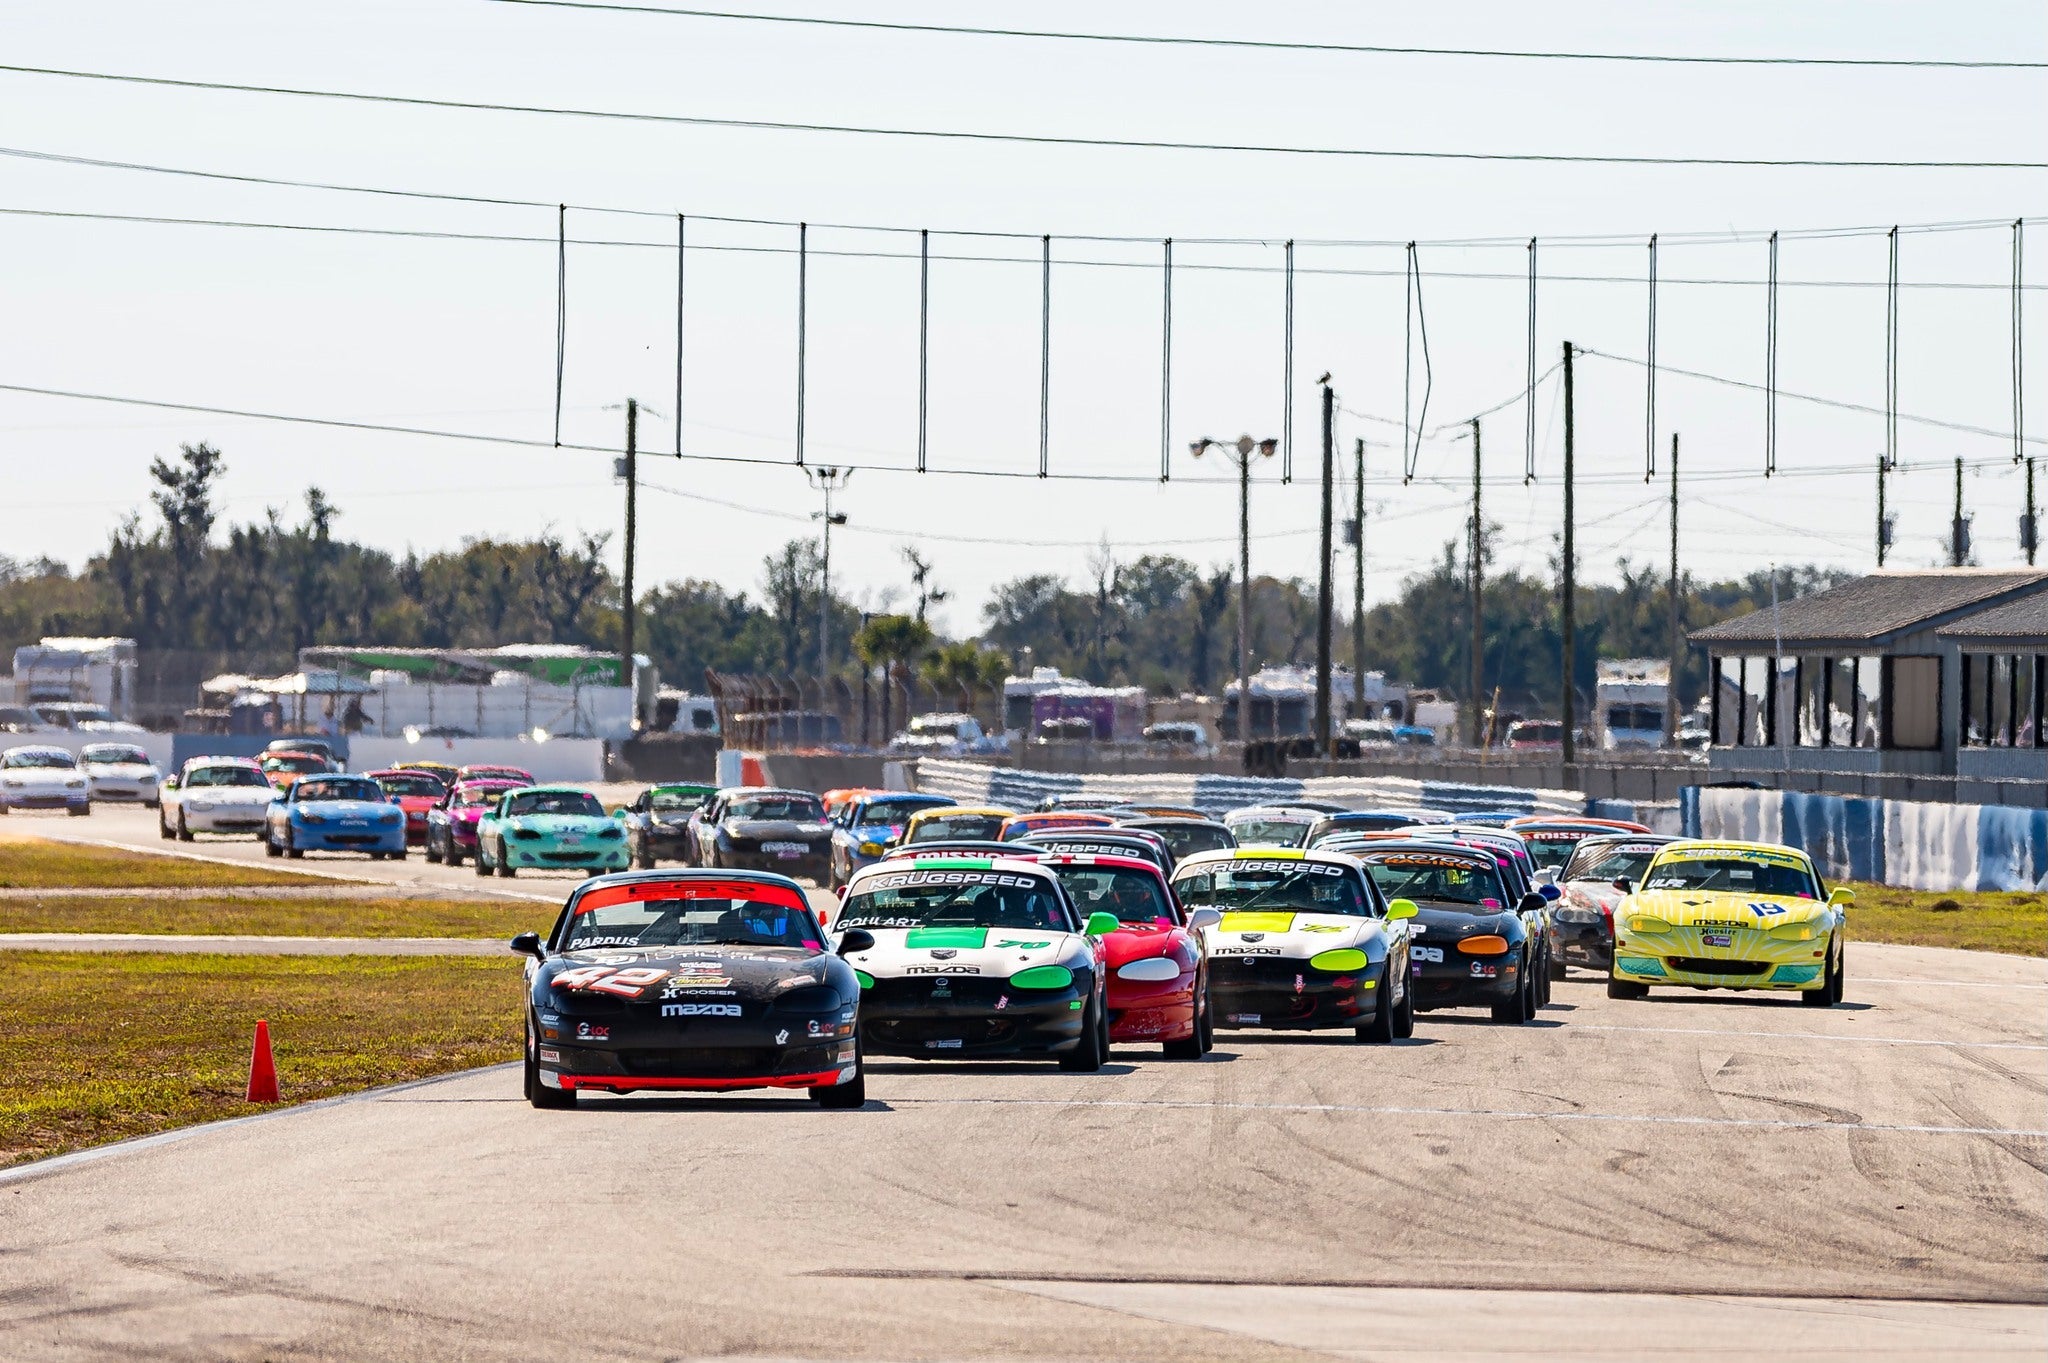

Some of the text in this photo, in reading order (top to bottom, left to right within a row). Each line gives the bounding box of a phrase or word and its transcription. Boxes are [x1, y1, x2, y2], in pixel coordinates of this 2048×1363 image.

[1384, 858, 1473, 870] RACING
[1748, 902, 1787, 917] 19
[1693, 918, 1749, 928] mazda
[568, 936, 641, 950] PARDUS
[1215, 947, 1282, 956] mazda
[906, 966, 981, 975] mazda
[680, 989, 737, 997] HOOSIER
[661, 1003, 742, 1018] mazda
